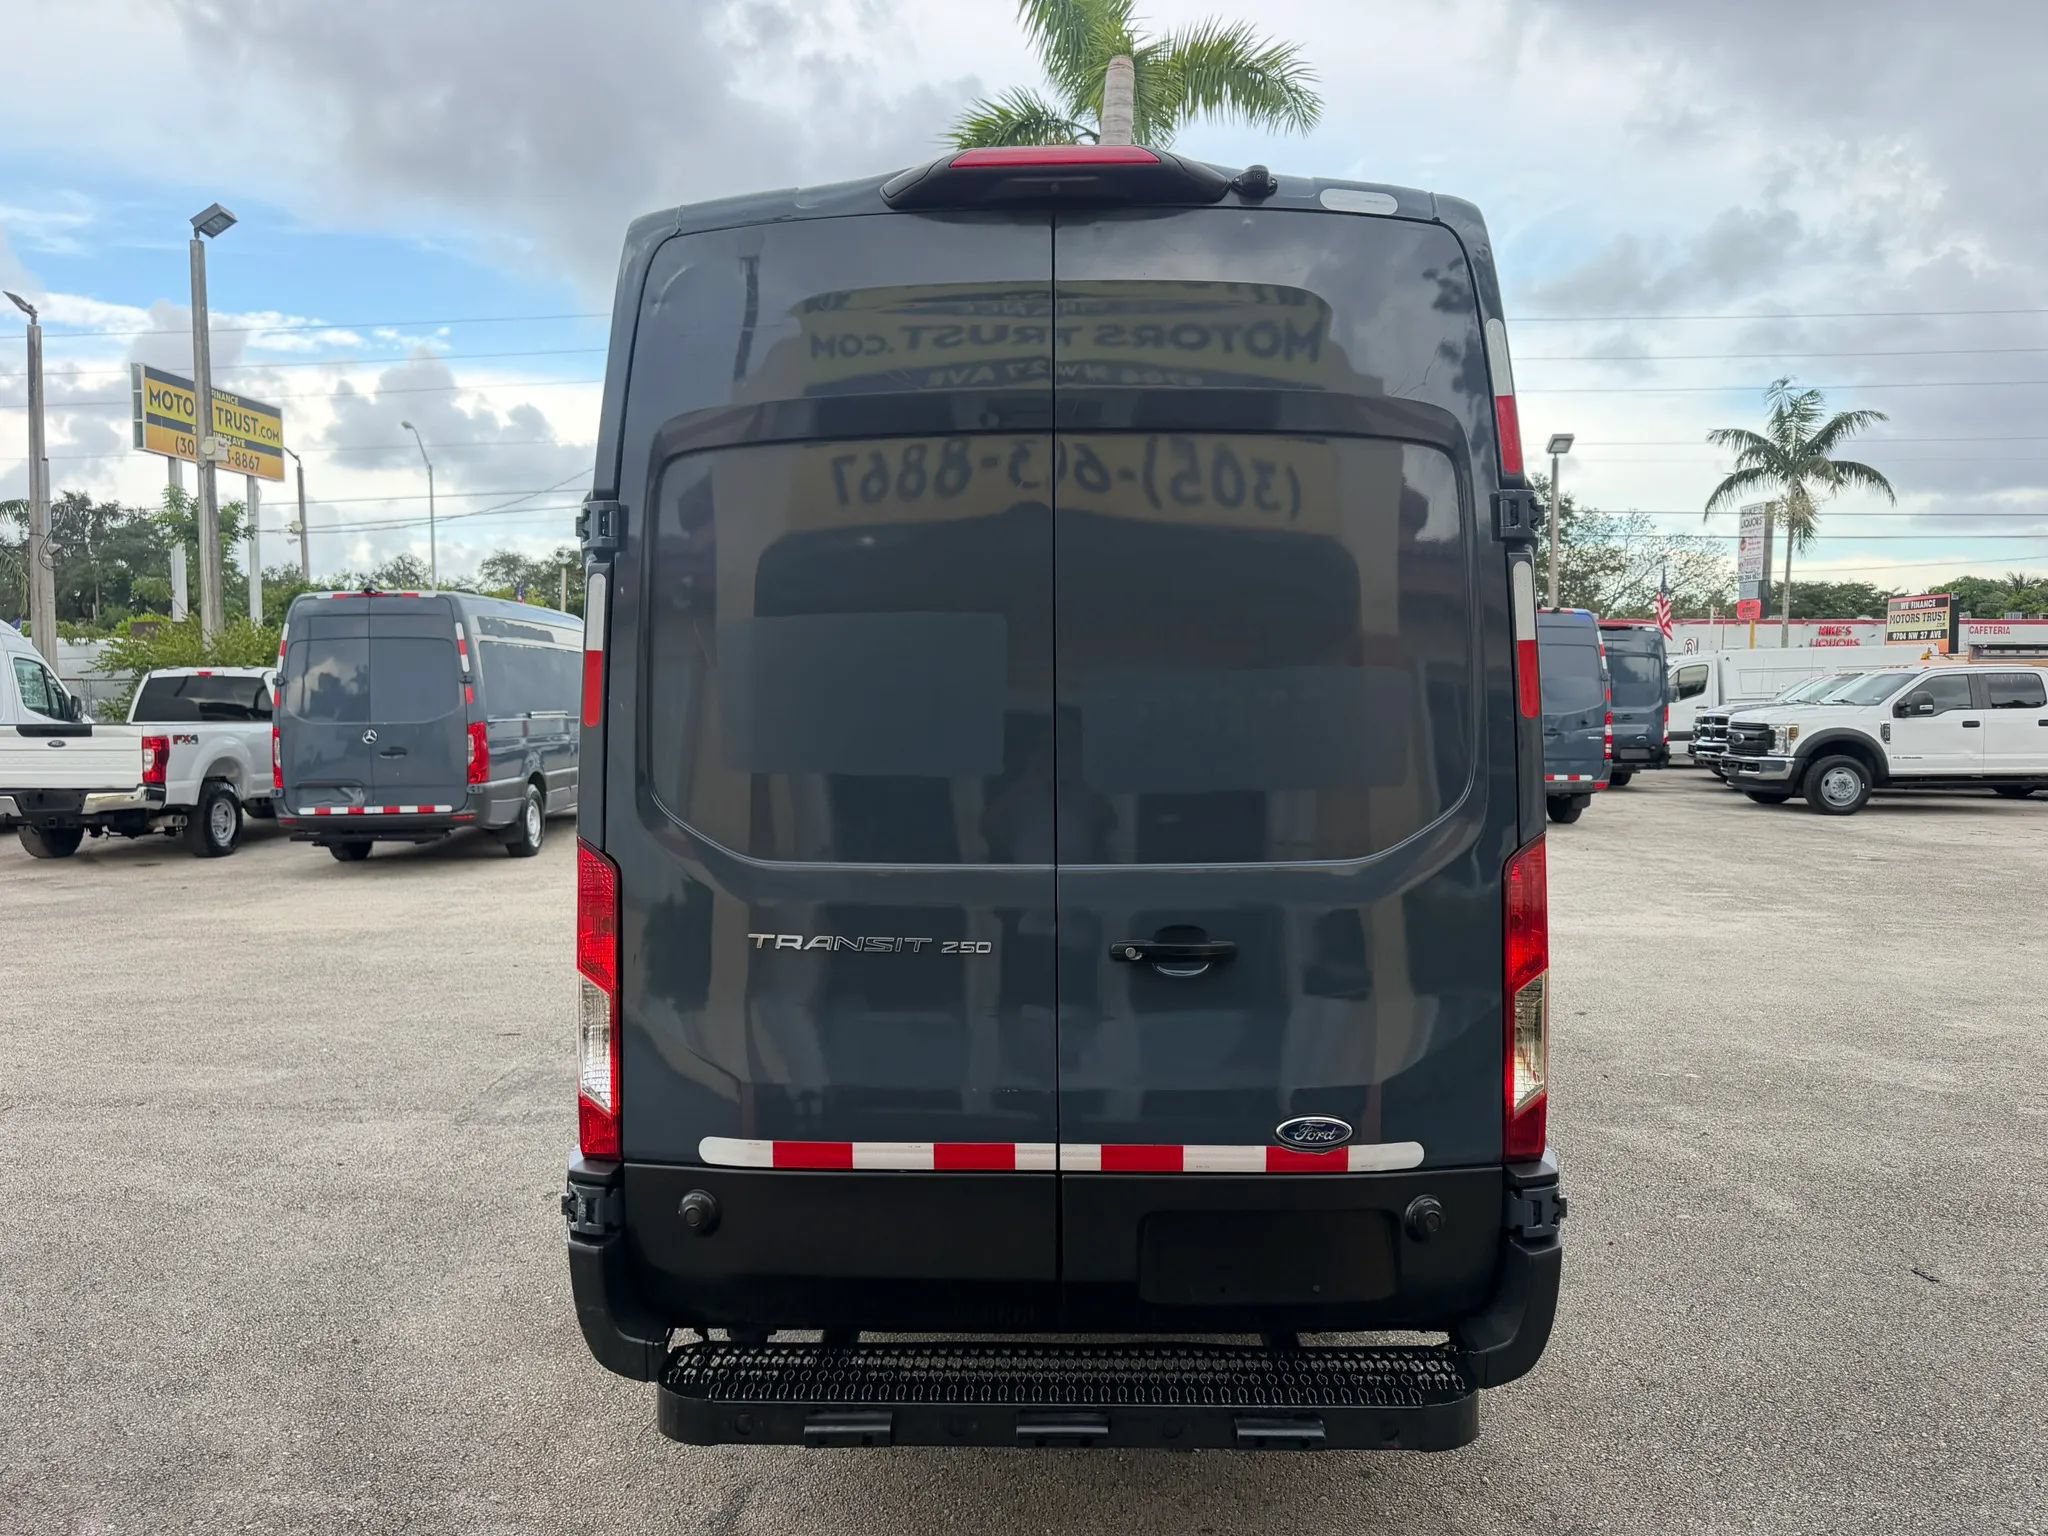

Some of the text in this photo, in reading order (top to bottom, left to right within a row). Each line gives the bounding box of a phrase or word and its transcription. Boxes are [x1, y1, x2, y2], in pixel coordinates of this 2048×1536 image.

[1911, 599, 1937, 609] FINANCE
[1889, 610, 1948, 625] MOTORS TRUST
[1818, 625, 1852, 636] MIKE'S
[1908, 631, 1919, 640] NW
[1920, 631, 1928, 639] 27
[1930, 630, 1942, 639] AVE
[1969, 625, 2011, 635] CAFETERIA
[173, 735, 199, 744] FX4
[747, 933, 992, 953] TRANSIT 250
[1294, 1122, 1336, 1141] Ford
